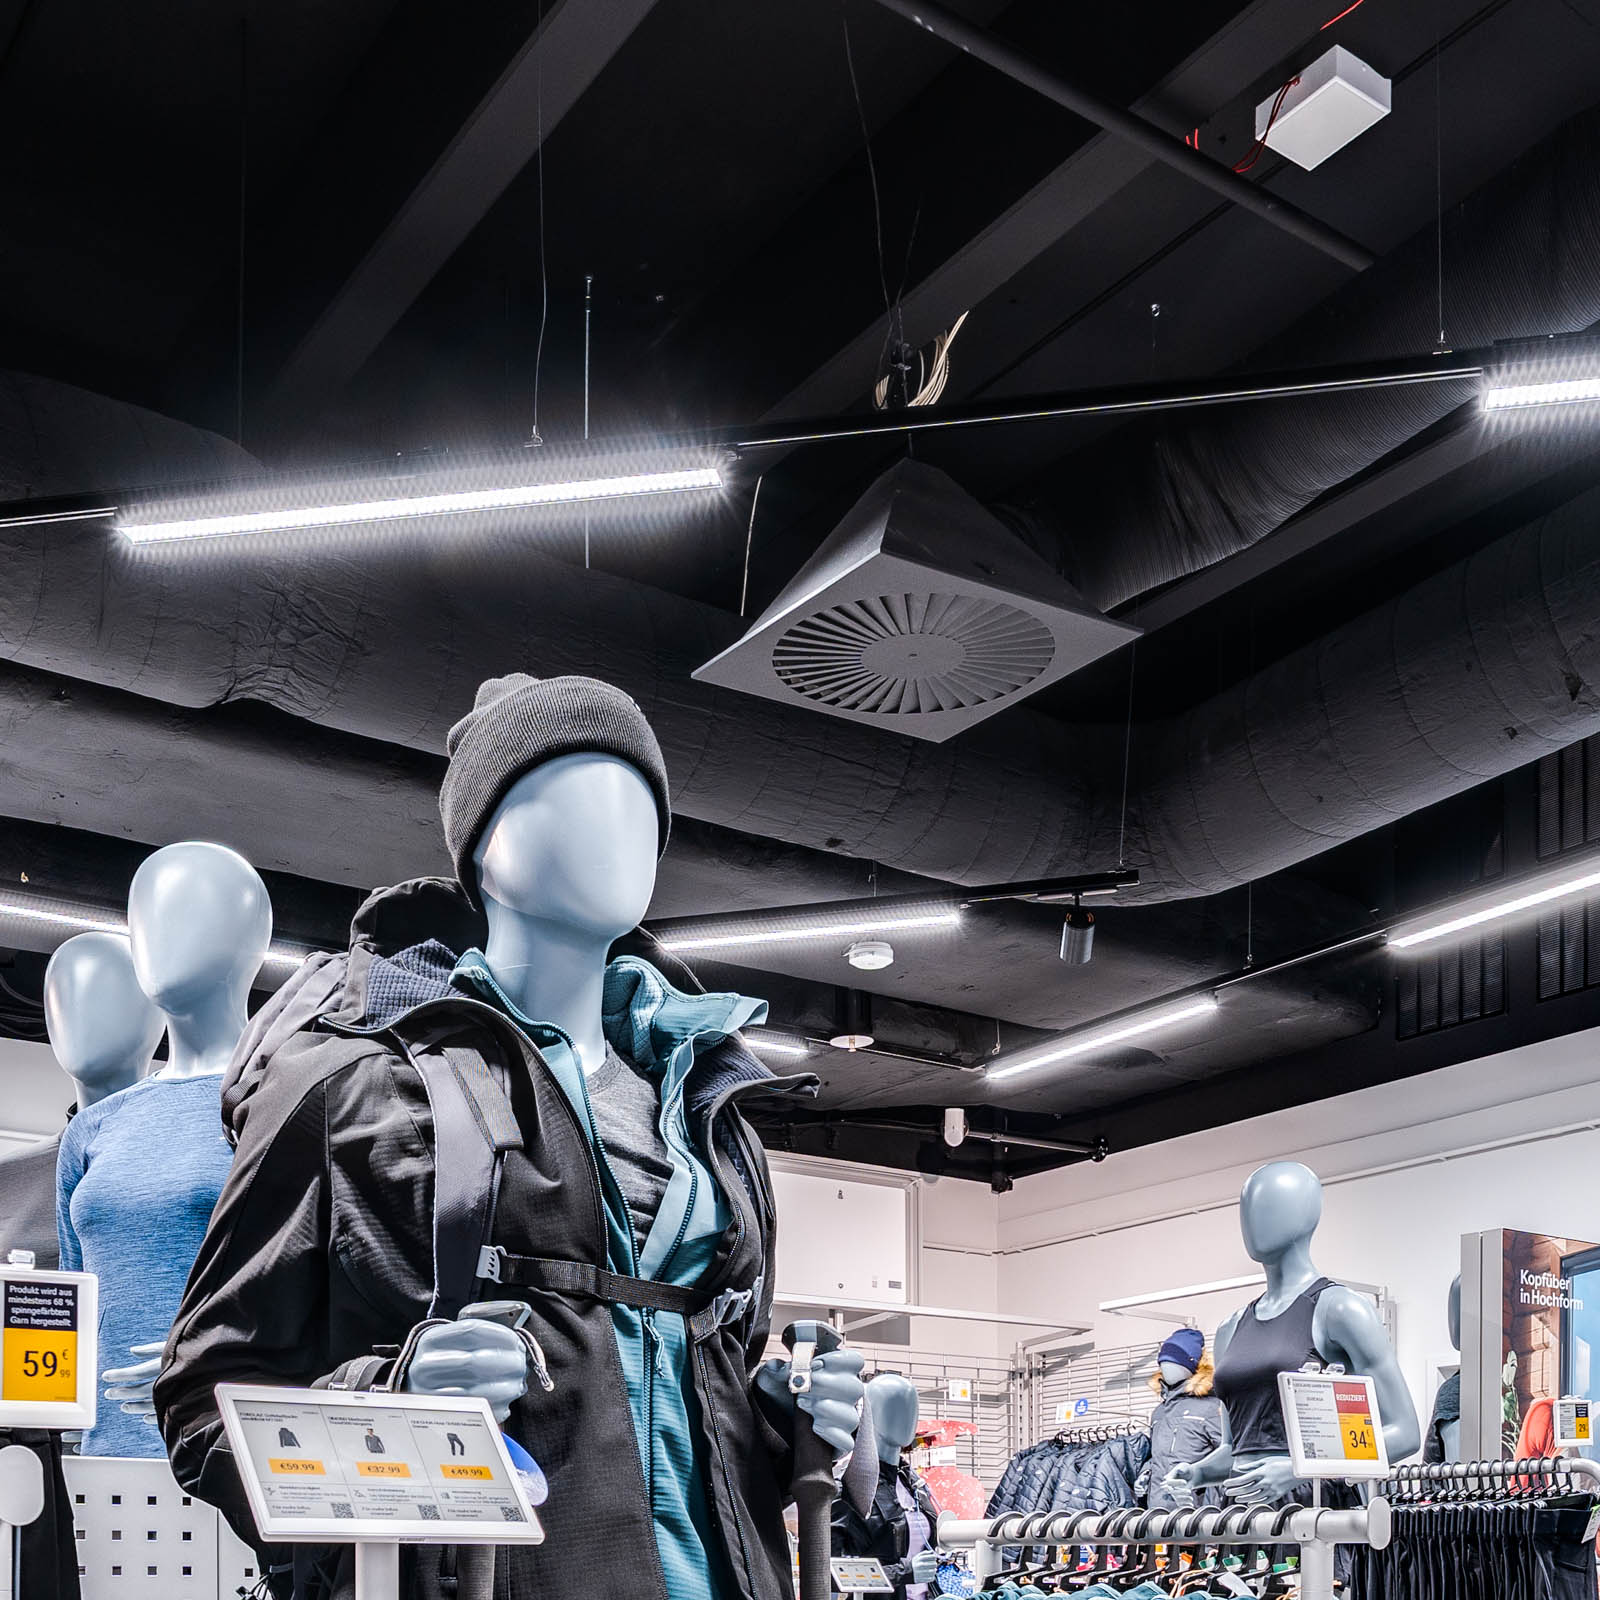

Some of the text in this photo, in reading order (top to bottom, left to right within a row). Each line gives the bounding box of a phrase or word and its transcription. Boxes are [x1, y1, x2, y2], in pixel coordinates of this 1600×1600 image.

[1520, 1269, 1570, 1290] Kopfüber
[9, 1285, 39, 1295] Produkt
[40, 1287, 58, 1296] wird
[8, 1296, 74, 1307] mindestens 68 %
[1520, 1288, 1584, 1310] in Hochform
[11, 1306, 70, 1317] spinngefärbtem
[10, 1316, 29, 1324] Garn
[31, 1317, 71, 1328] hergestellt
[62, 1349, 68, 1360] €
[23, 1350, 57, 1377] 59
[60, 1370, 70, 1378] 99
[1349, 1430, 1367, 1448] 34
[280, 1463, 315, 1471] €59.99
[367, 1465, 401, 1474] €32.99
[450, 1469, 483, 1477] €49.99
